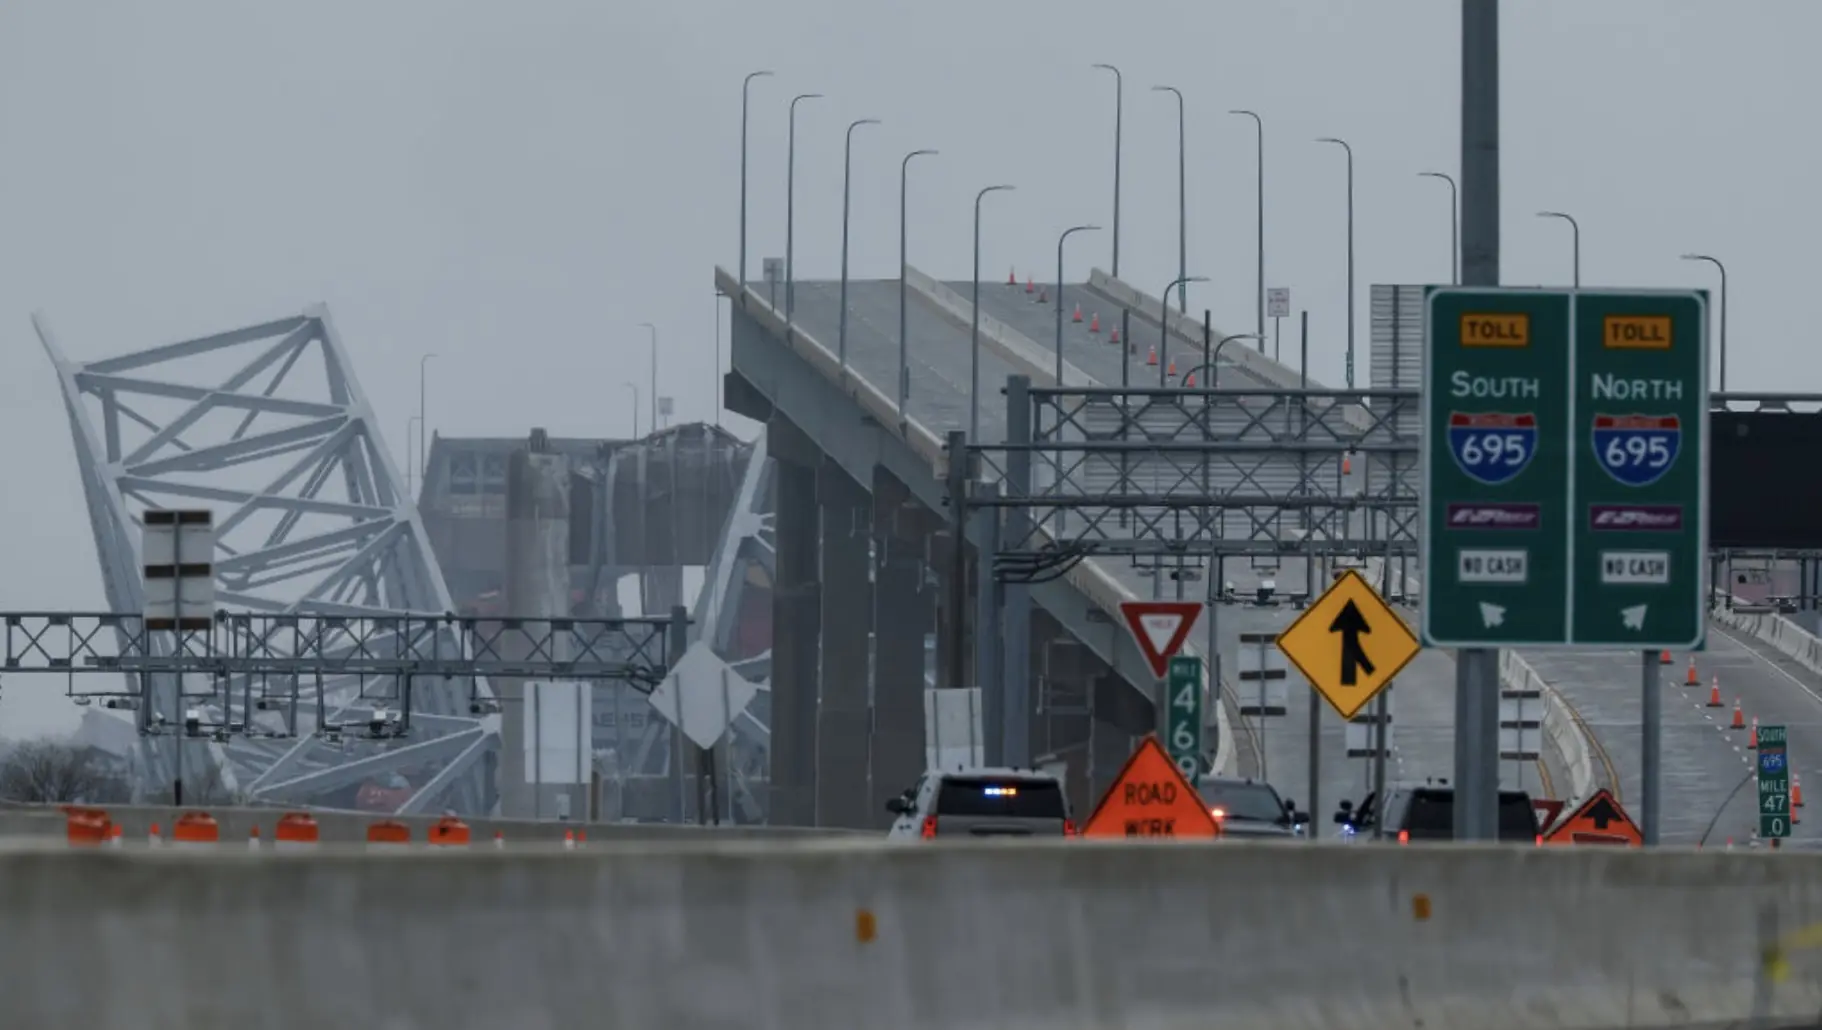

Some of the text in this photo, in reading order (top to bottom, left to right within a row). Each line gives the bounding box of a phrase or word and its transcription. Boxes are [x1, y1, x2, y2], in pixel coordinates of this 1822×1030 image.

[1466, 320, 1523, 339] TOLL
[1610, 322, 1665, 341] TOLL
[1450, 370, 1540, 398] SOUTH
[1591, 373, 1682, 399] NORTH
[1461, 434, 1526, 466] 695
[1605, 436, 1669, 467] 695
[1463, 556, 1523, 575] NO CASH
[1606, 558, 1665, 576] NO CASH
[1757, 727, 1787, 742] SOUTH
[1763, 754, 1782, 768] 695
[1124, 783, 1177, 806] ROAD
[1760, 779, 1787, 793] MILE
[1763, 794, 1786, 812] 47
